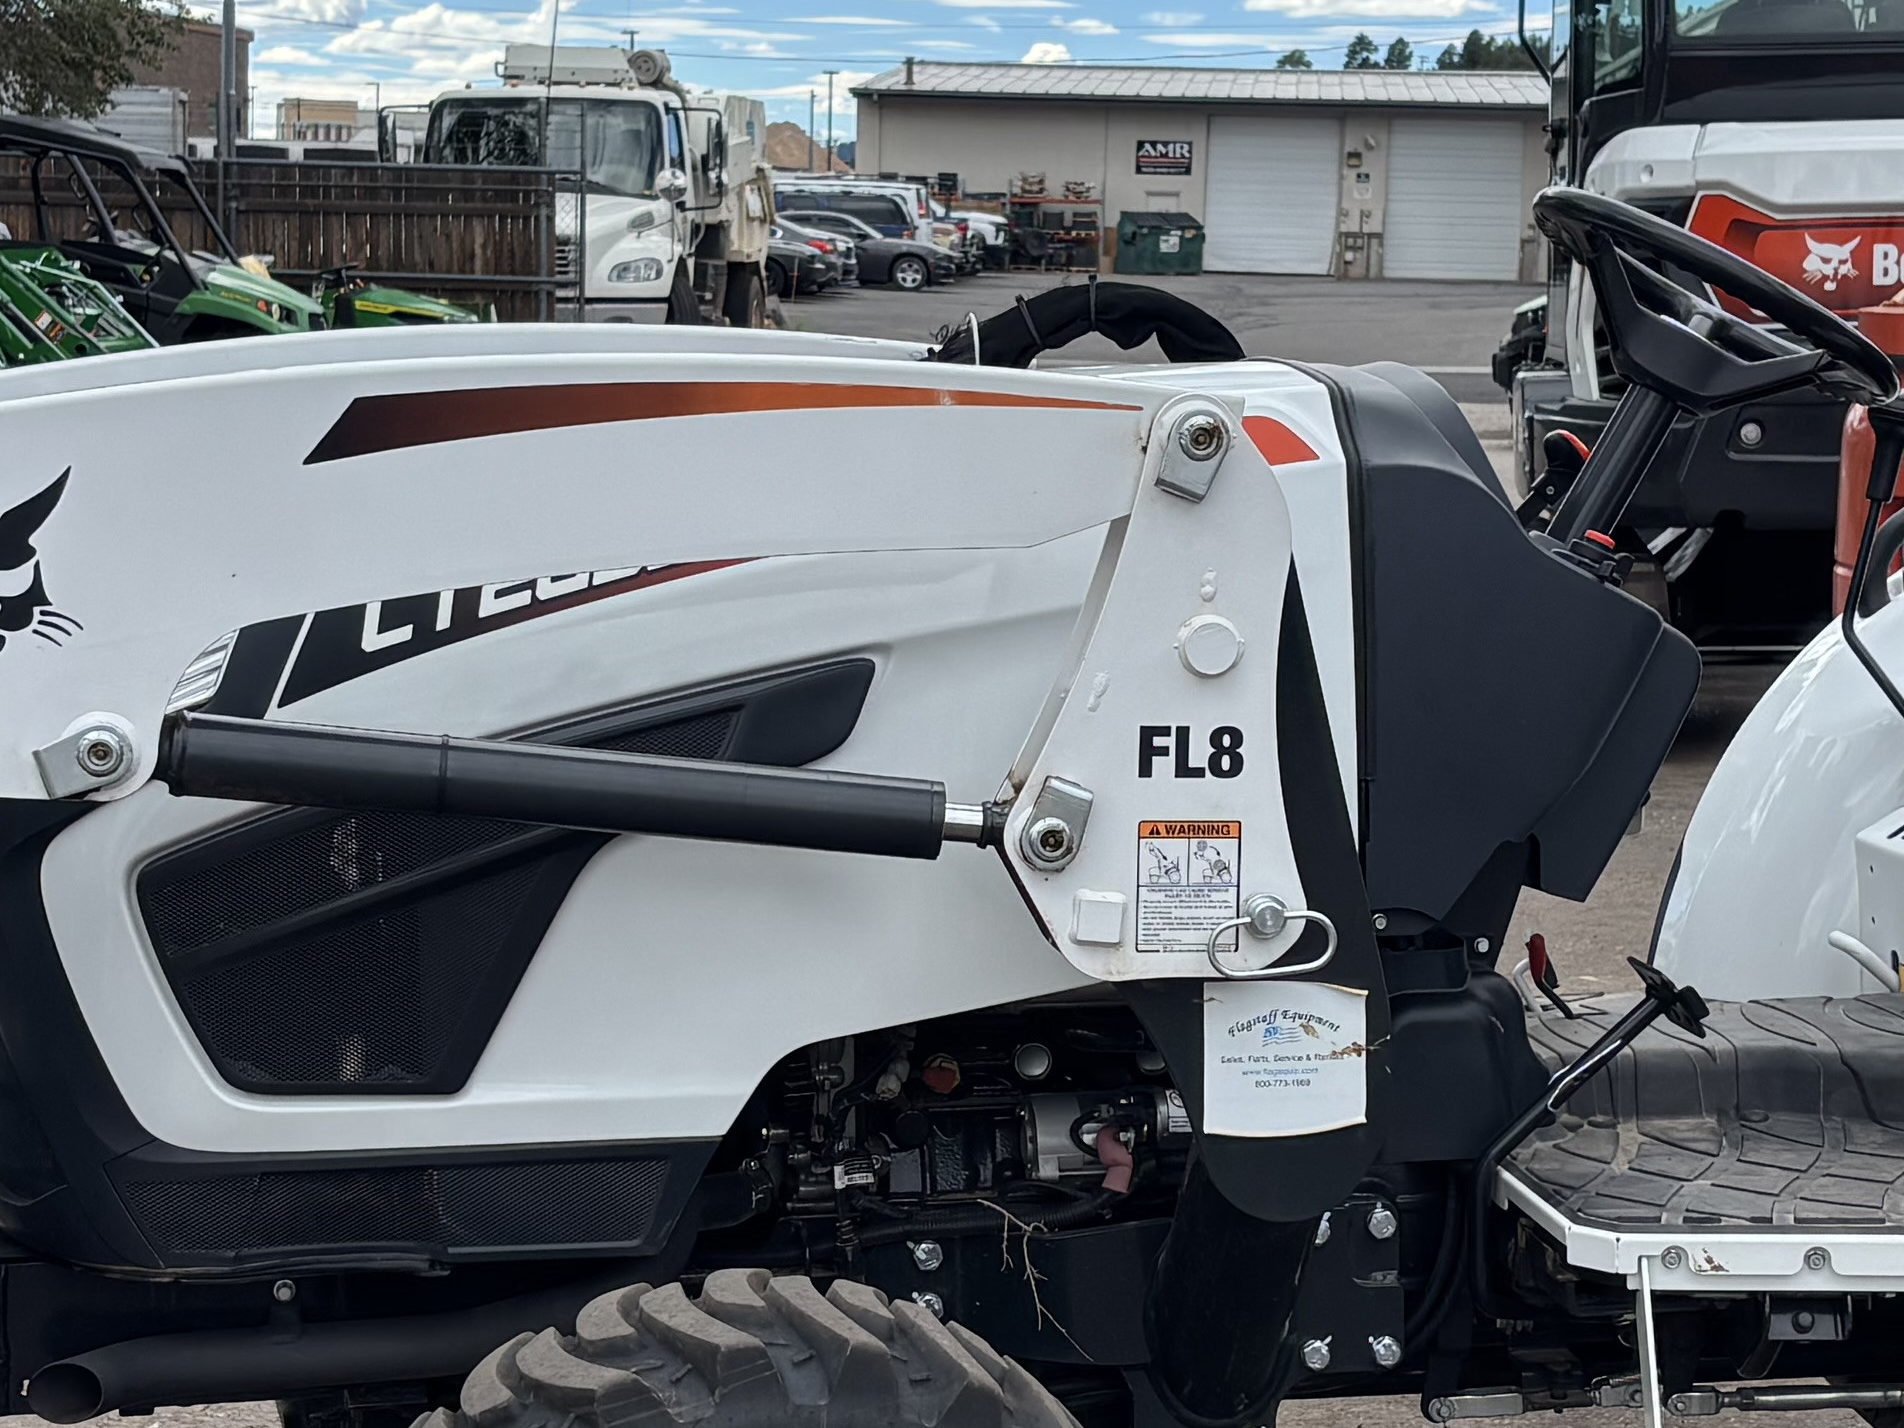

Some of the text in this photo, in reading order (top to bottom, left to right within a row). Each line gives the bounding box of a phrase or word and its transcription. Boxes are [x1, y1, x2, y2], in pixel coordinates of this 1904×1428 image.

[1137, 142, 1191, 158] AMR
[1138, 725, 1245, 779] FL8
[1164, 824, 1231, 836] WARNING
[1228, 1009, 1341, 1037] Flagstaff Equipment
